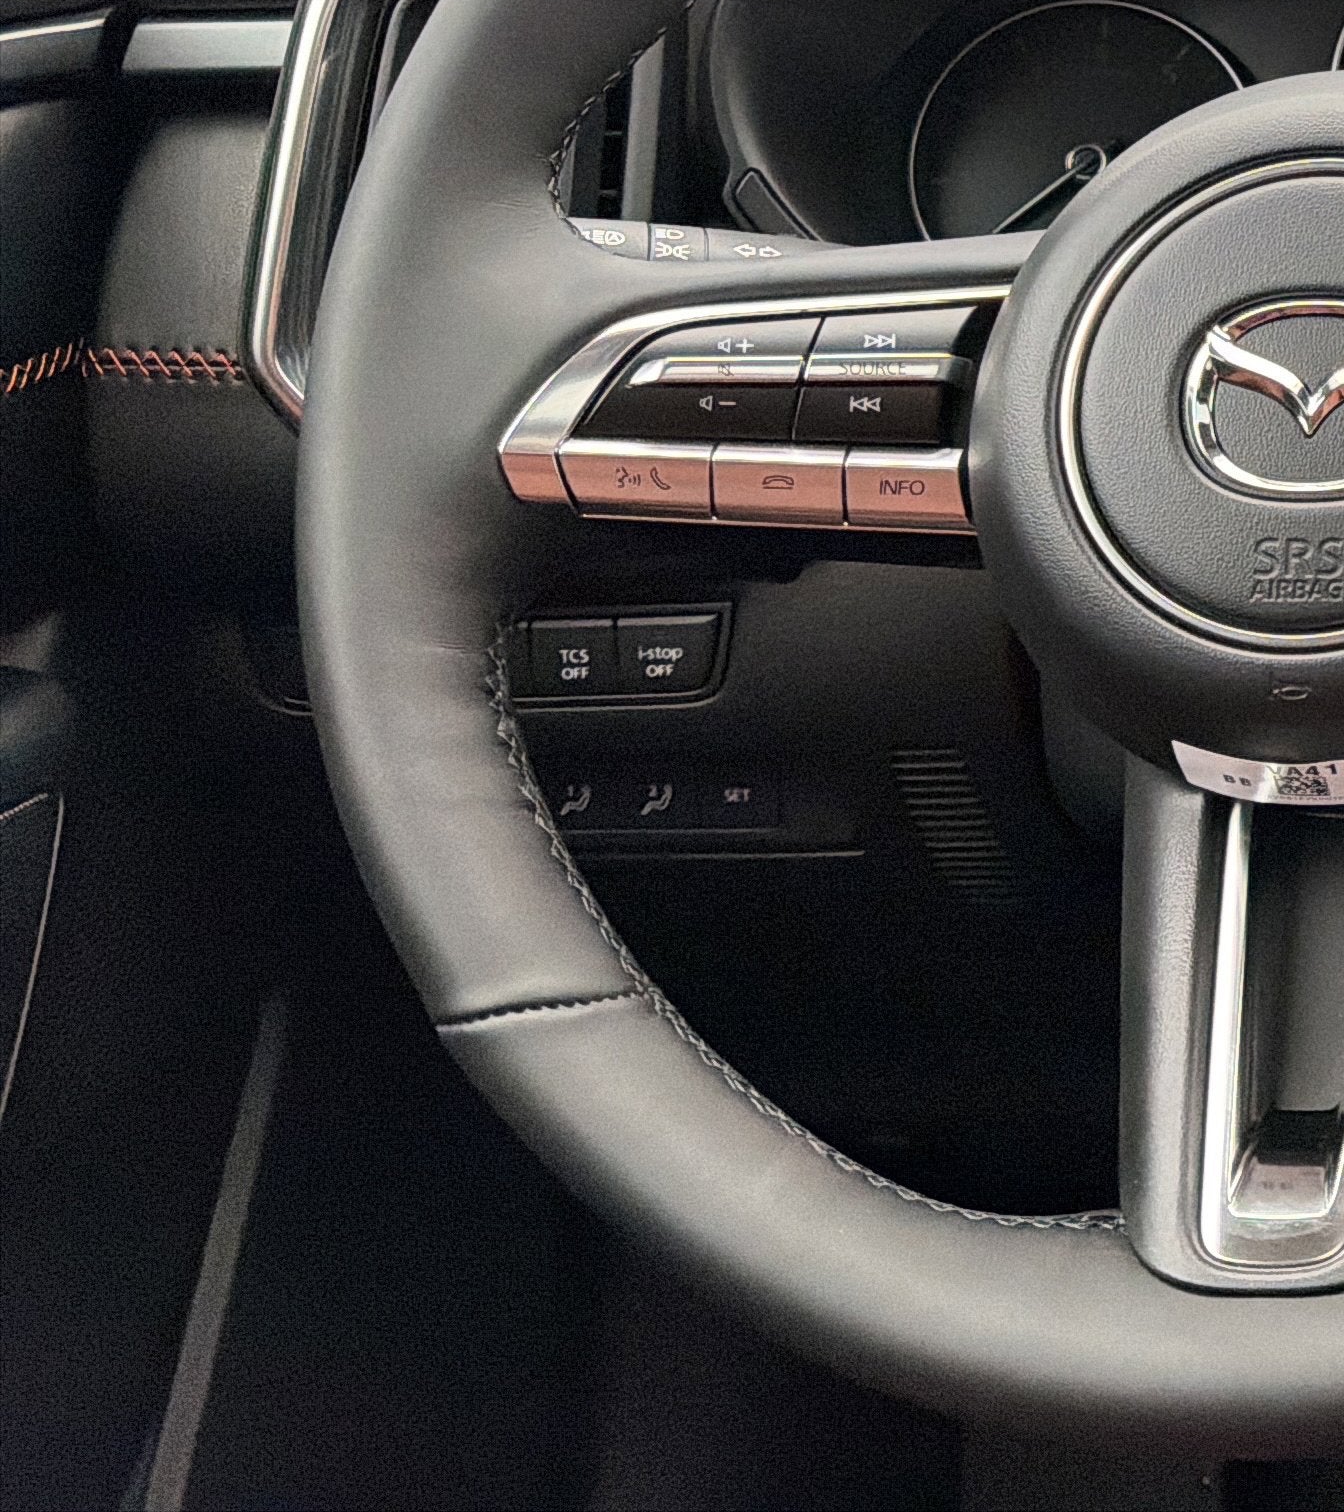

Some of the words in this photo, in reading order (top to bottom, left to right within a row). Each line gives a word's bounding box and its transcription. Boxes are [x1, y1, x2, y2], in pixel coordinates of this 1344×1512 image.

[838, 361, 907, 376] SOURCE
[879, 479, 925, 496] INFO
[1250, 578, 1344, 603] AIRBAG
[559, 648, 590, 664] TCS
[637, 646, 684, 661] i-stop
[561, 666, 590, 680] OFF
[645, 663, 674, 678] OFF
